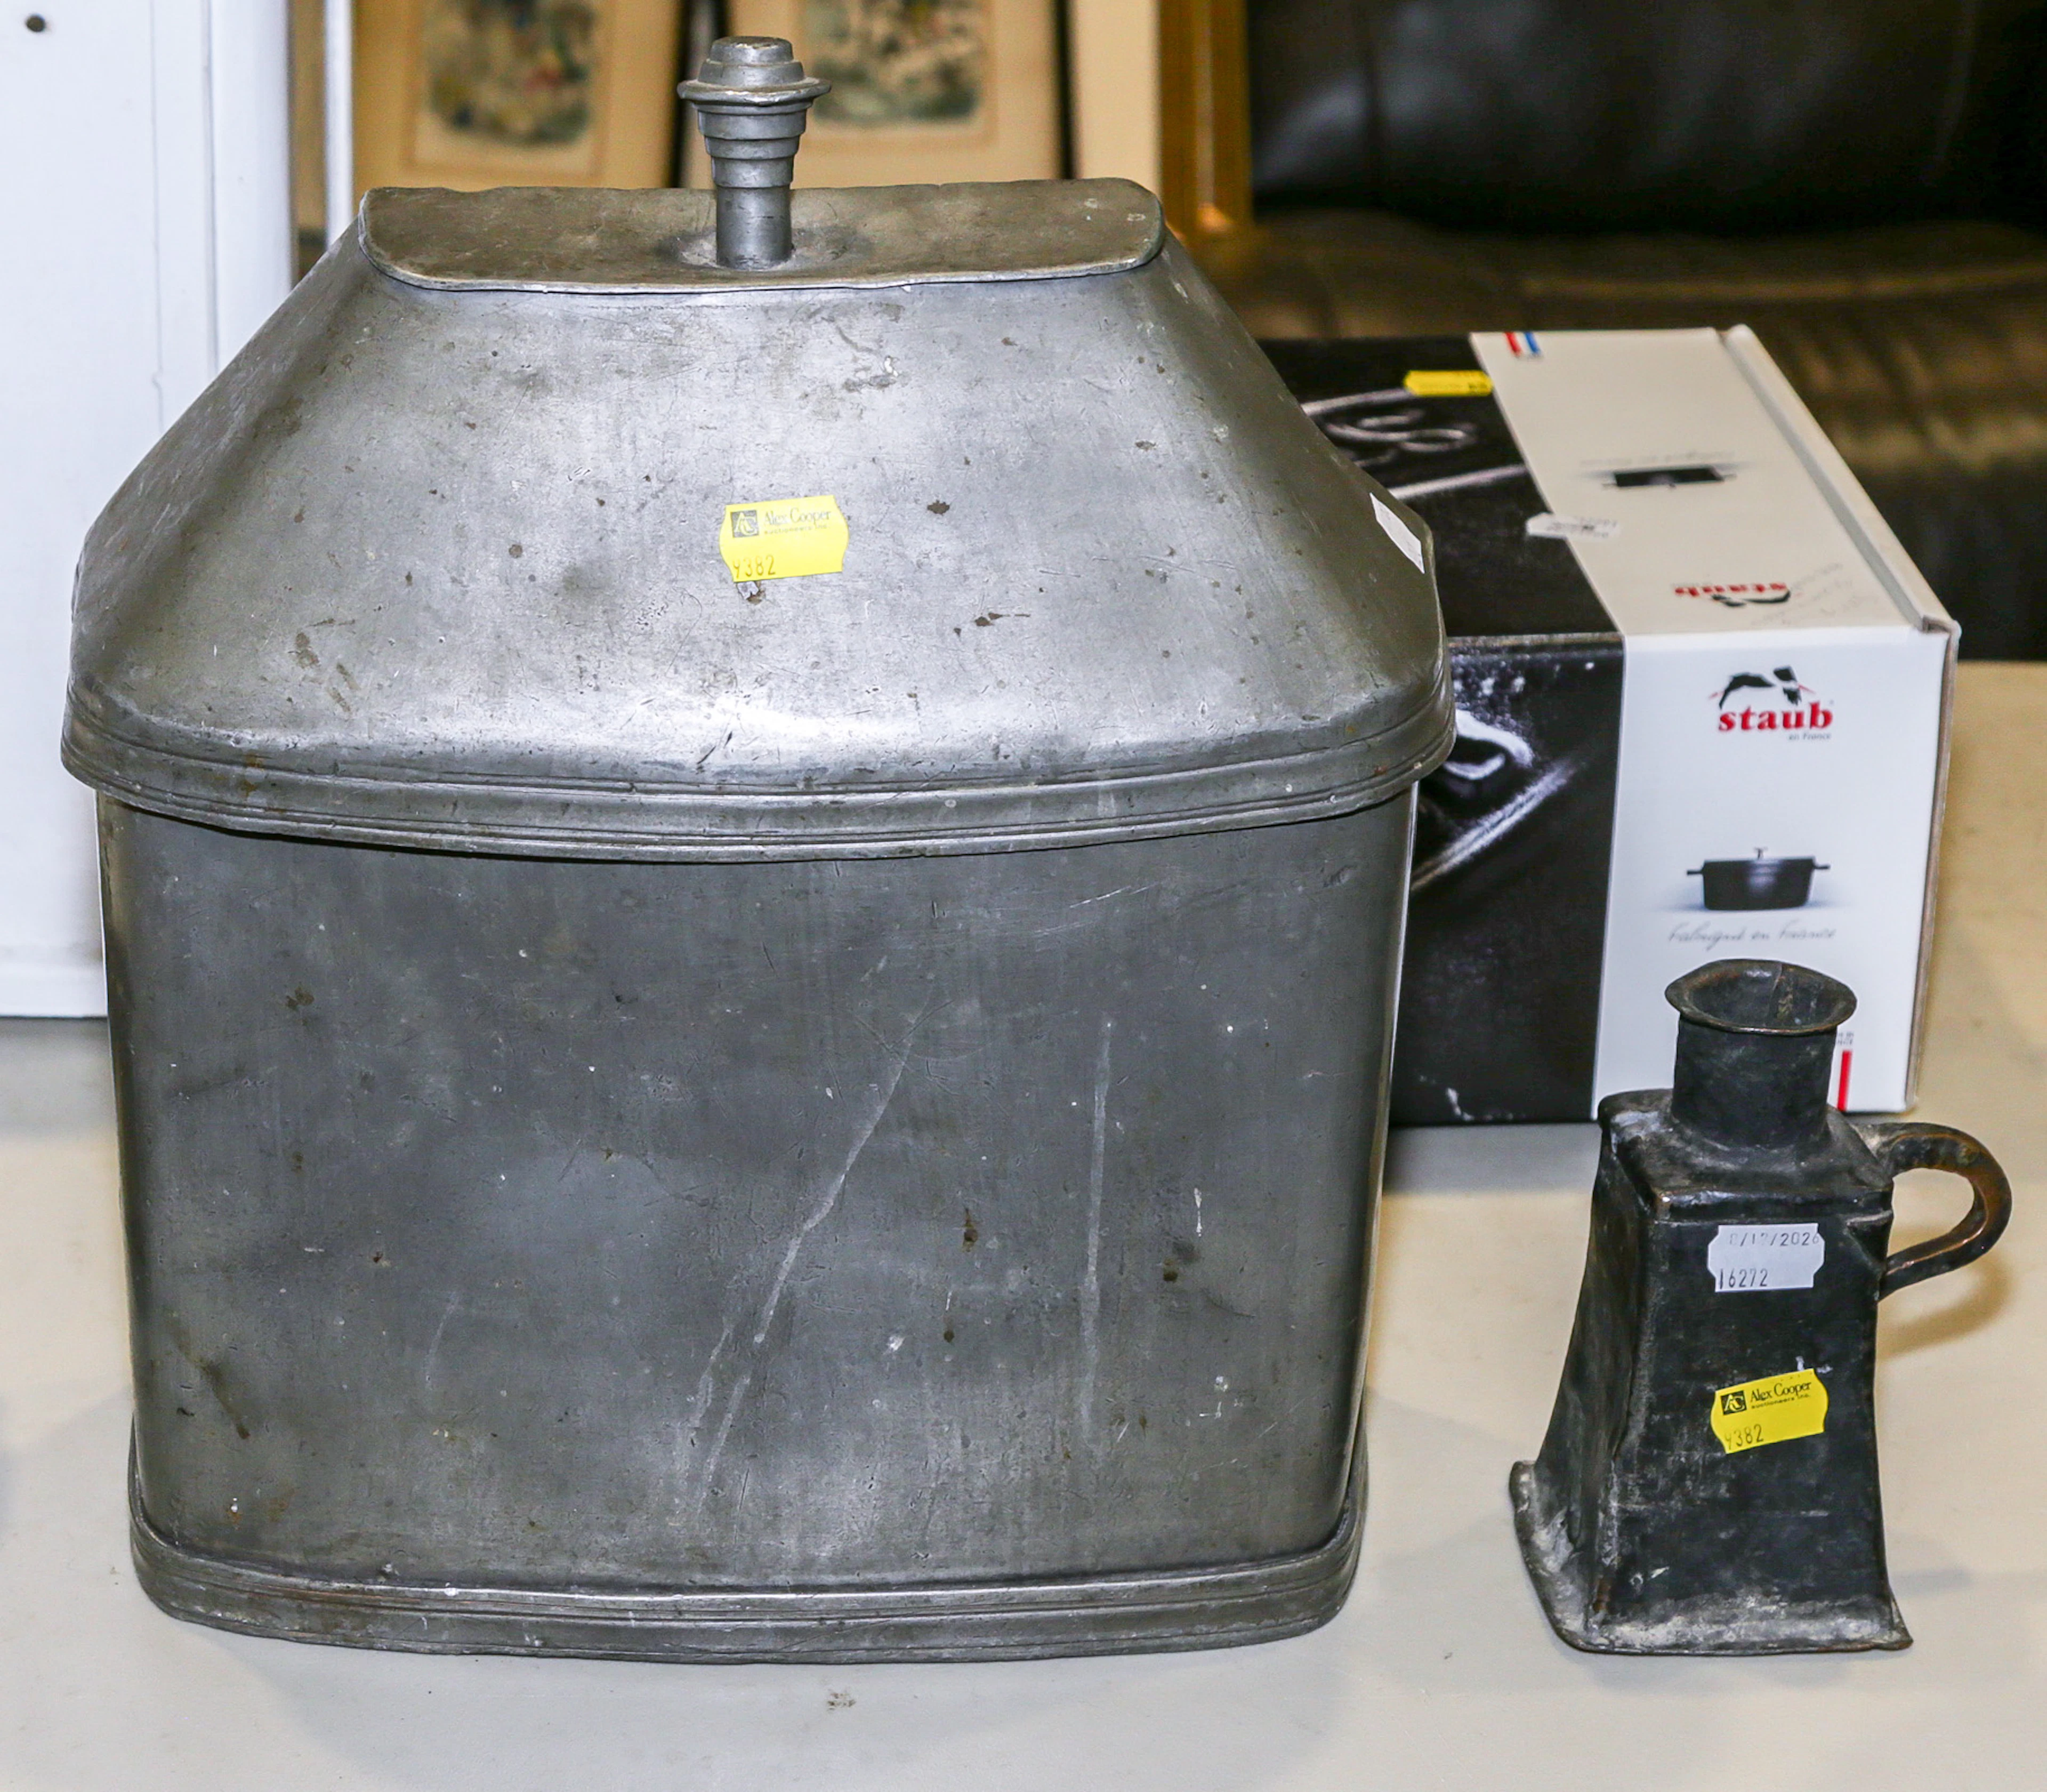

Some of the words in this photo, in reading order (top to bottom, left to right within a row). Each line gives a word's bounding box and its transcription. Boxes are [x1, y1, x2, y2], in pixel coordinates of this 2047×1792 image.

[764, 511, 788, 525] Alex
[790, 507, 832, 525] Cooper
[1719, 701, 1833, 732] staub
[1720, 1268, 1768, 1290] 16272
[1751, 1388, 1773, 1403] Alex
[1774, 1382, 1812, 1397] Cooper
